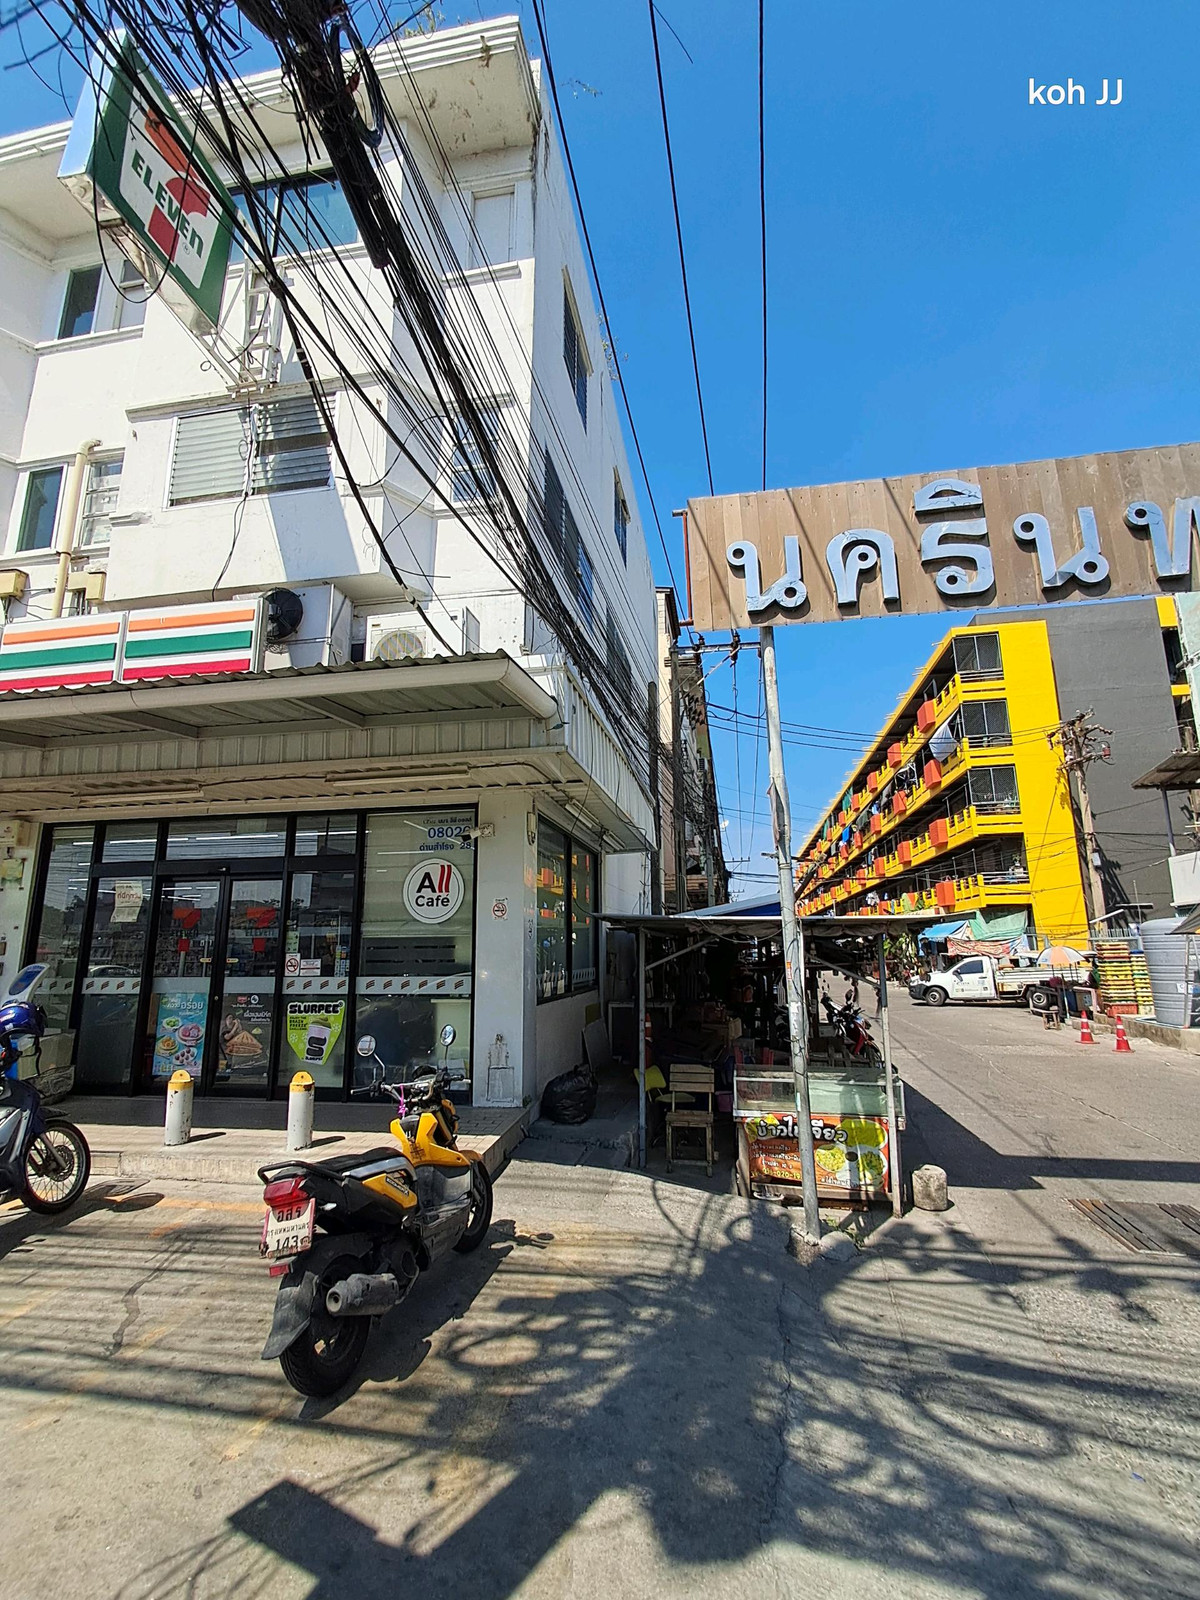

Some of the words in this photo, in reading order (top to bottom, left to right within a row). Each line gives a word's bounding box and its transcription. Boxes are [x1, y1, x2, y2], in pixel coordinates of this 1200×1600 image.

[415, 864, 453, 894] All
[415, 893, 450, 908] Café
[288, 1003, 340, 1014] SLURPEE
[276, 1235, 299, 1250] 143
